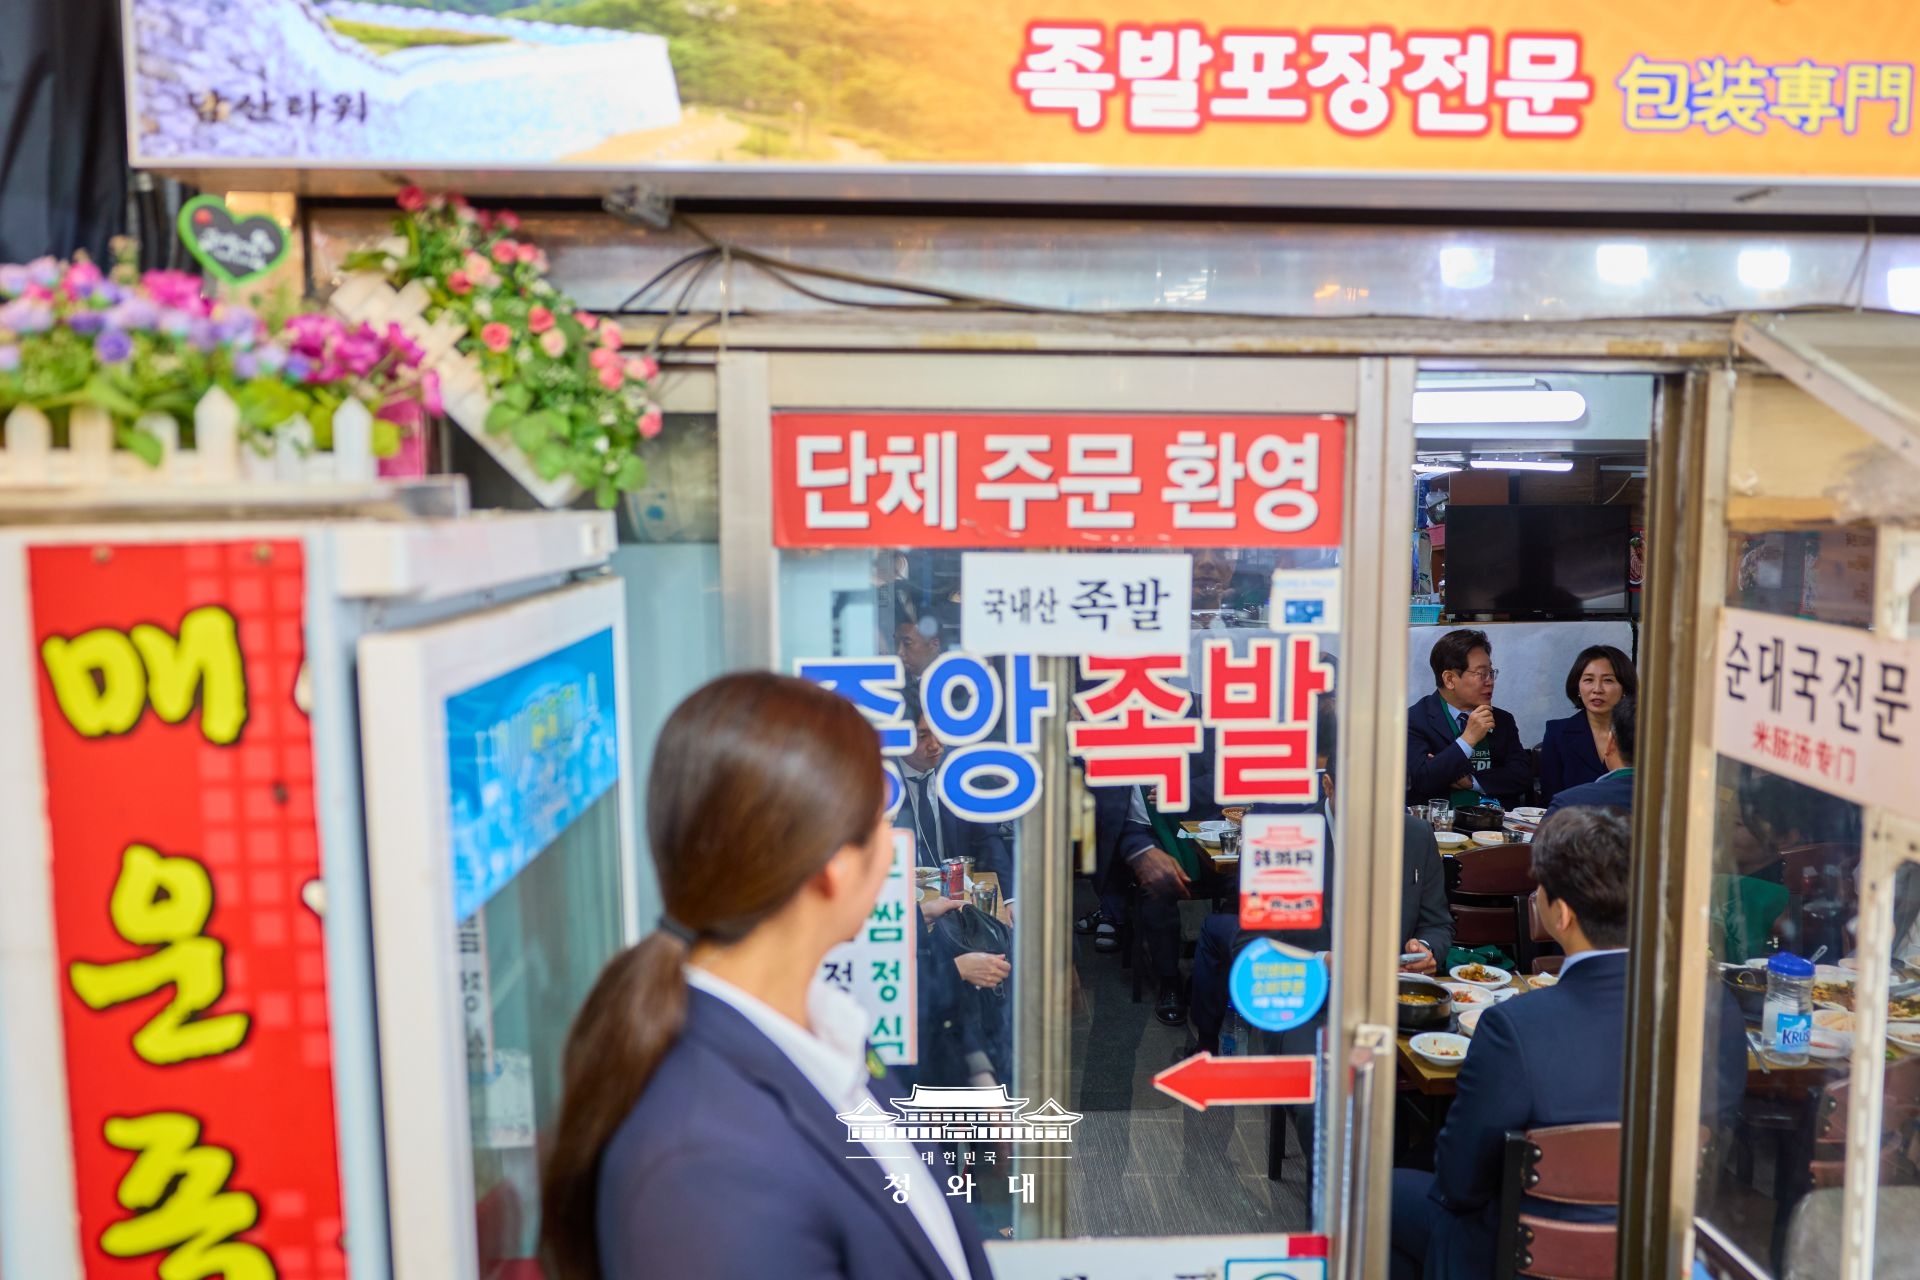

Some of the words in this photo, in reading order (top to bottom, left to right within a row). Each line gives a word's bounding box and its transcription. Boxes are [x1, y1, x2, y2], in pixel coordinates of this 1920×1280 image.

[1014, 25, 1592, 136] 족발포장전문
[796, 431, 957, 531] 단체
[976, 434, 1142, 530] 주문
[1161, 431, 1320, 532] 환영
[984, 586, 1059, 624] 국내산
[1070, 577, 1170, 631] 족발
[1068, 633, 1335, 813] 족발
[1725, 630, 1910, 745] 순대국전문
